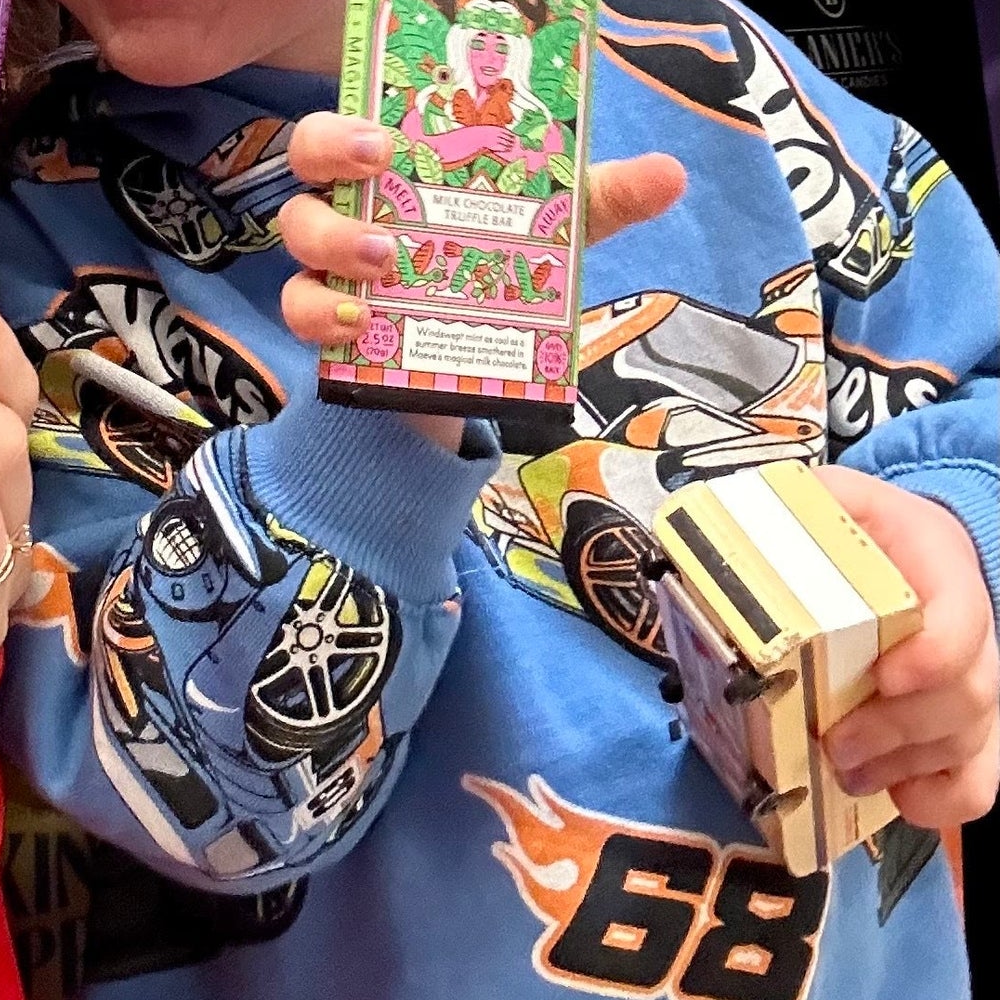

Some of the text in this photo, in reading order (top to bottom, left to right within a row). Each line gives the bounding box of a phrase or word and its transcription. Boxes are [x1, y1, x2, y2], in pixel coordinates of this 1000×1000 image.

[789, 31, 903, 70] ANIER'S
[342, 36, 364, 116] MAGICA
[383, 177, 417, 214] MELT
[433, 194, 525, 217] MILK CHOCOLATE
[444, 209, 513, 228] TRUFFLE BAR
[415, 340, 448, 350] summer
[475, 355, 491, 366] milk
[549, 833, 830, 1000] 68
